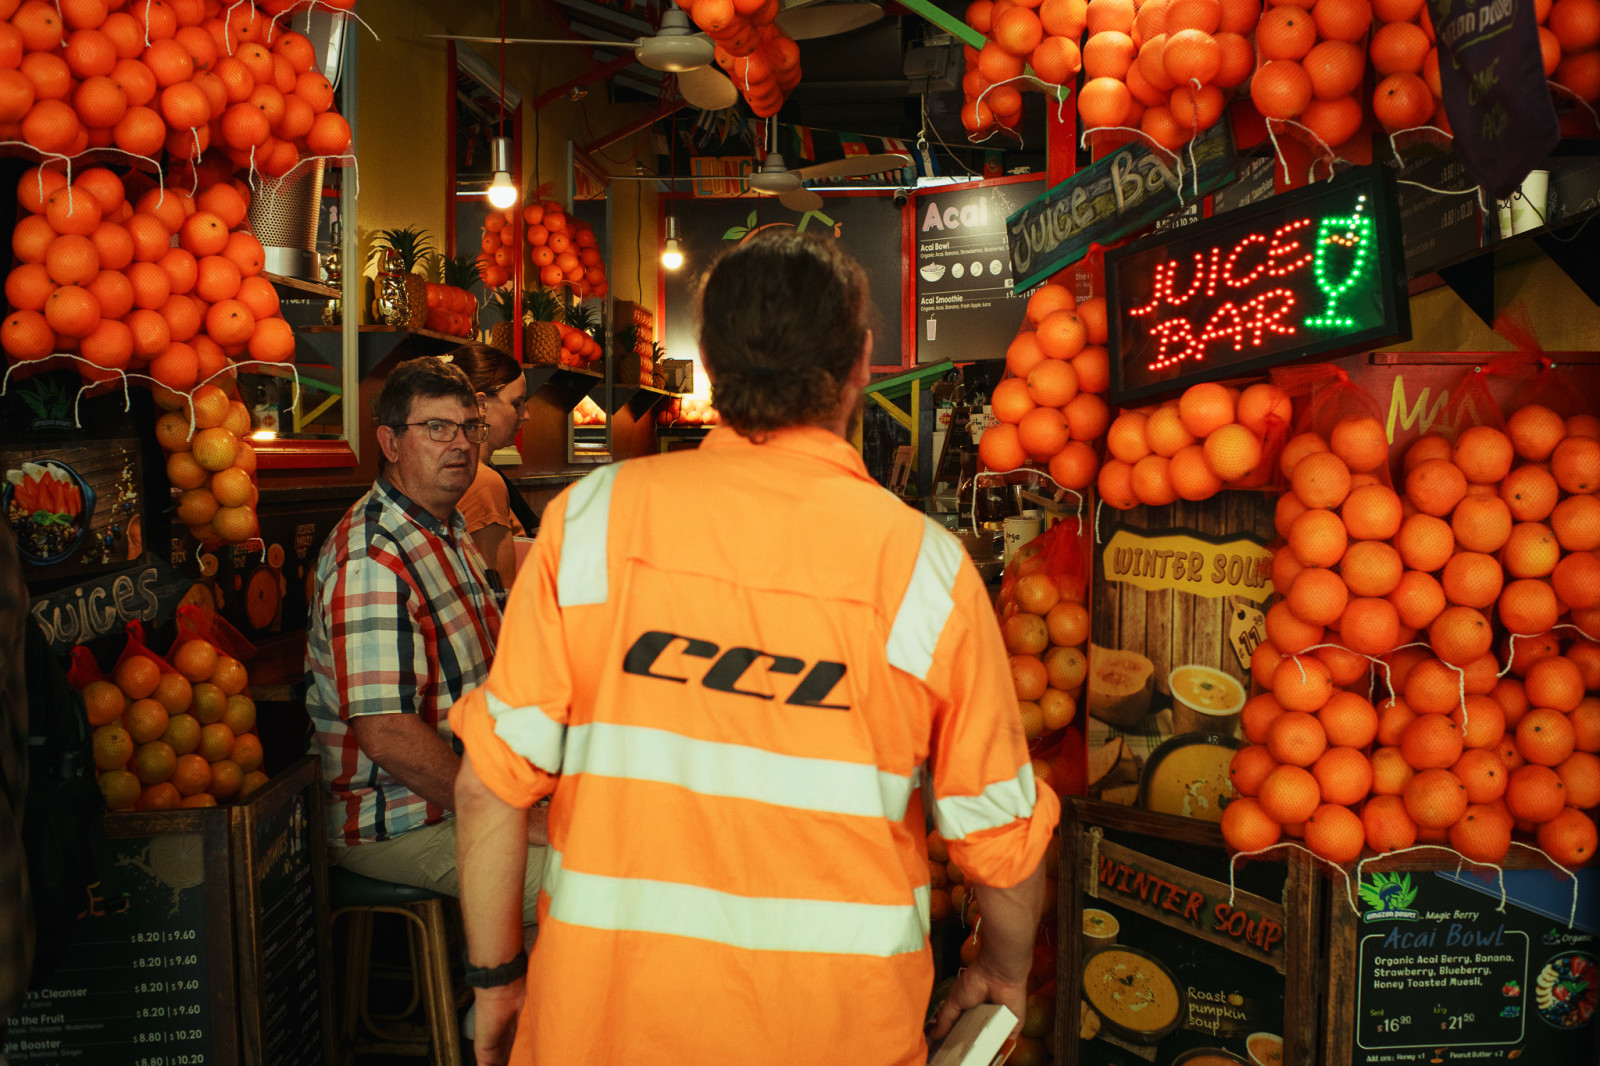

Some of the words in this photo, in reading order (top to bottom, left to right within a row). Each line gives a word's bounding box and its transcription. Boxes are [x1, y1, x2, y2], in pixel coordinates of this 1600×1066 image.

[695, 159, 751, 195] LUNC
[921, 196, 988, 232] Acai
[1011, 186, 1095, 274] Juice
[920, 244, 935, 252] Acai
[934, 241, 950, 250] Bowl
[1130, 218, 1312, 316] JUICE
[920, 296, 935, 305] Acai
[935, 294, 964, 304] Smoothie
[1148, 287, 1296, 371] BAR
[1113, 546, 1204, 582] WINTER
[623, 630, 851, 711] CCL
[1099, 855, 1205, 923] WINTER
[1213, 902, 1284, 952] SOUP
[1366, 911, 1394, 920] amazon
[1394, 910, 1417, 919] power
[1425, 910, 1451, 923] Magic
[1453, 909, 1480, 922] Berry
[130, 931, 160, 944] $8.20
[167, 929, 196, 941] $9.60
[1383, 925, 1438, 950] Acai
[1445, 922, 1505, 947] Bowl
[132, 956, 161, 969] $8.20
[169, 954, 198, 966] $9.60
[1374, 955, 1415, 967] Organic
[1416, 954, 1439, 964] Acai
[41, 988, 88, 1000] Cleanser
[134, 981, 163, 994] $8.20
[171, 979, 199, 992] $9.60
[1373, 979, 1404, 990] Honey
[1407, 977, 1447, 988] Toasted
[1187, 986, 1227, 1004] Roast
[7, 1017, 19, 1027] to
[21, 1015, 39, 1025] the
[40, 1013, 65, 1024] Fruit
[136, 1006, 165, 1019] $8.20
[172, 1004, 201, 1016] $9.60
[1188, 1002, 1248, 1023] pumpkin
[1189, 1017, 1221, 1037] soup
[20, 1040, 61, 1051] Booster
[133, 1031, 161, 1045] $8.80
[169, 1029, 202, 1042] $10.20
[170, 1053, 204, 1066] $10.20
[1366, 1055, 1379, 1063] Add
[1396, 1053, 1416, 1061] Honey
[1449, 1051, 1472, 1059] Peanut
[1472, 1050, 1493, 1058] Butter
